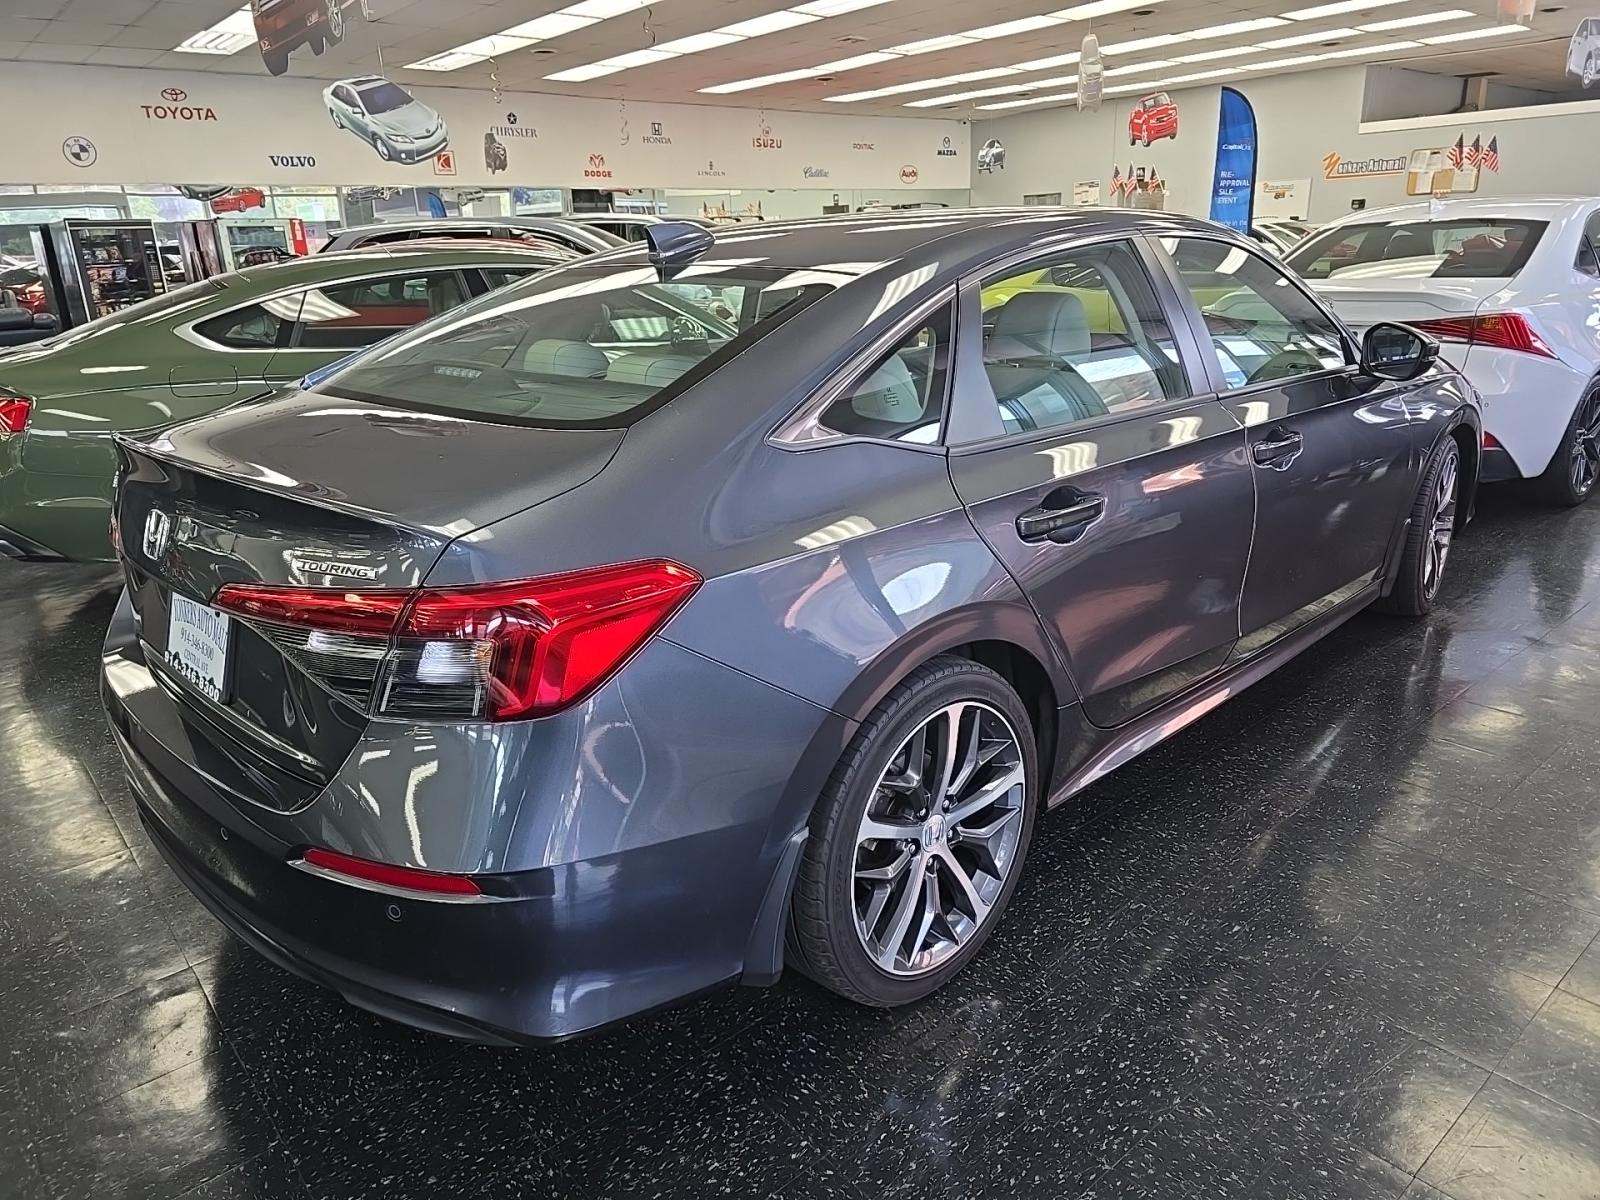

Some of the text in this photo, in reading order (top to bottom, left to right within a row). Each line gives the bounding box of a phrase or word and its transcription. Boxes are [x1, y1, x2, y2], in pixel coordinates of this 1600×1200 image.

[141, 105, 218, 121] TOYOTA
[490, 126, 538, 139] CHRYSLER
[642, 136, 672, 145] HONDA
[268, 155, 316, 167] VOLVO
[1368, 156, 1406, 172] Automall
[584, 169, 612, 178] DODGE
[803, 166, 829, 179] Cadillac
[301, 561, 369, 577] TOURING
